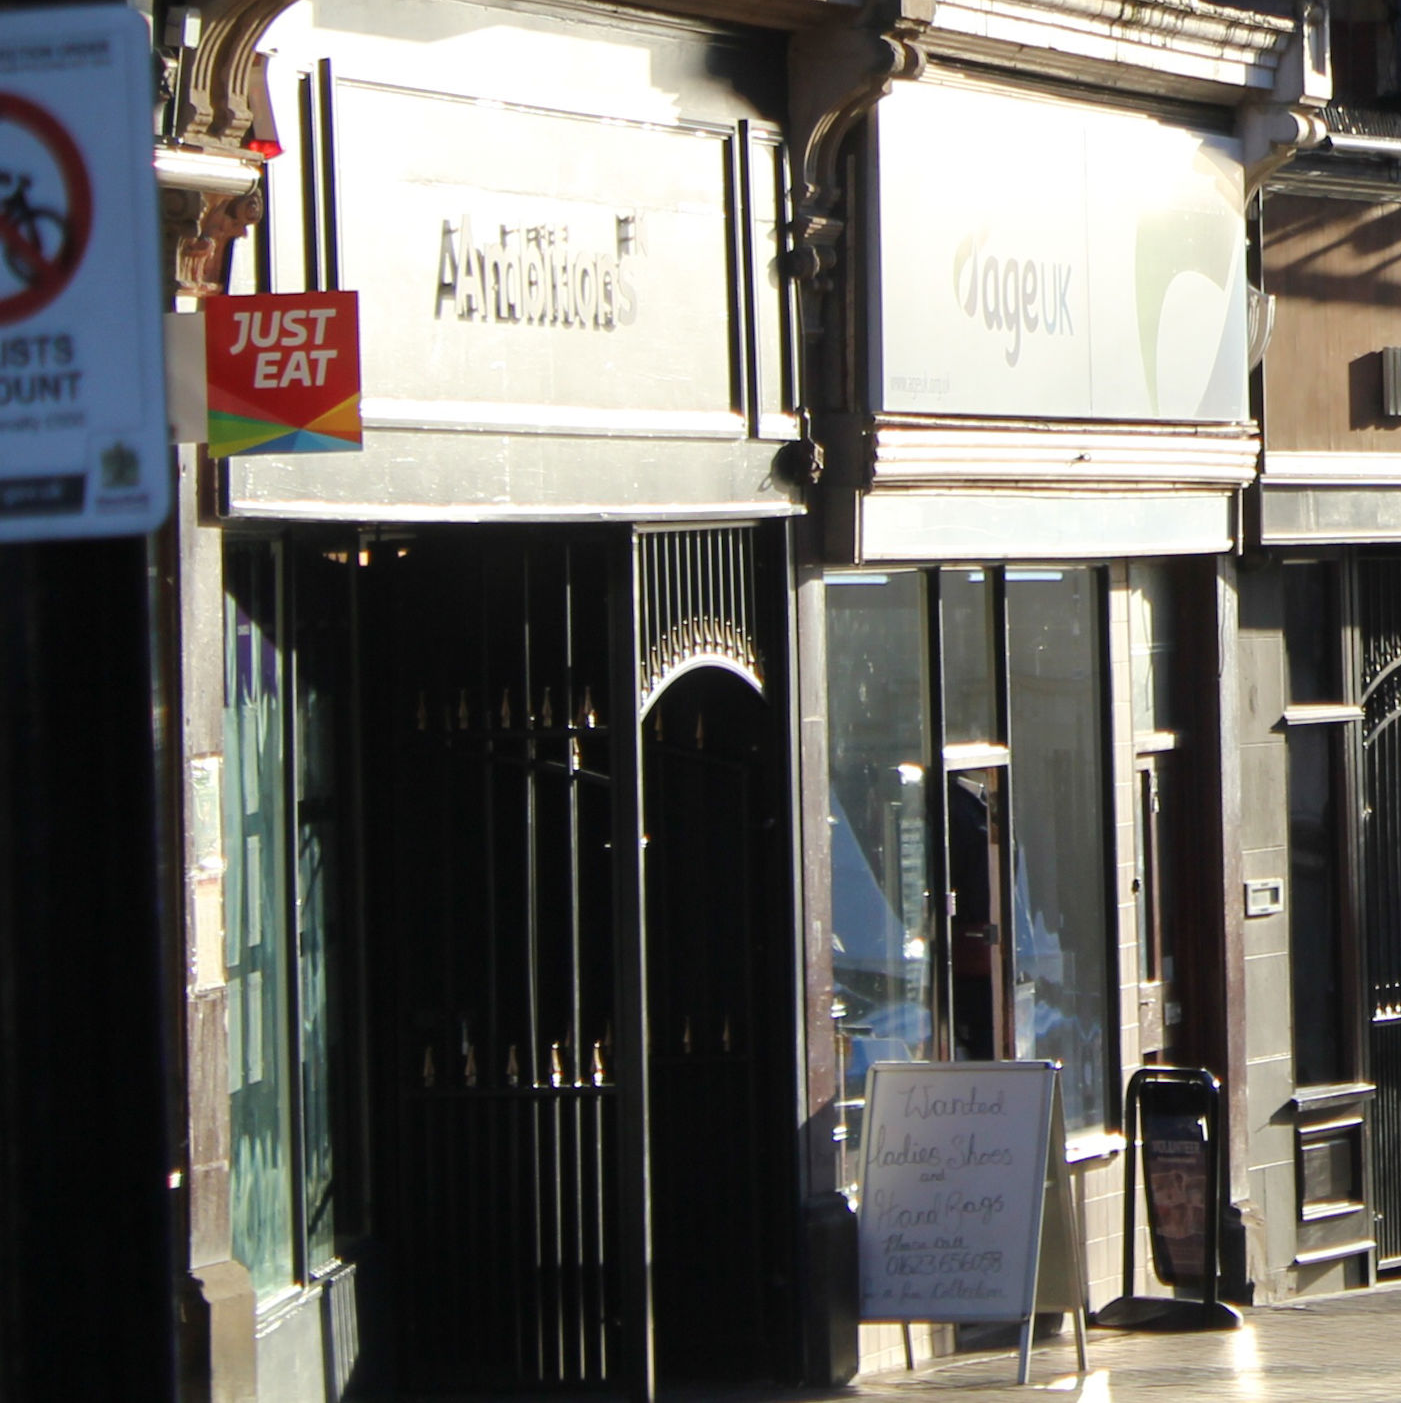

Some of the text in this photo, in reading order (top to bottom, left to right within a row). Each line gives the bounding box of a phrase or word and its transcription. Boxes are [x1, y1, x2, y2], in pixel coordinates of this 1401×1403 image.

[982, 254, 1074, 368] age UK
[229, 308, 337, 355] JUST
[253, 349, 338, 389] EAT
[898, 1083, 1008, 1120] Wanted
[946, 1132, 1013, 1170] Shoes
[919, 1169, 947, 1183] and
